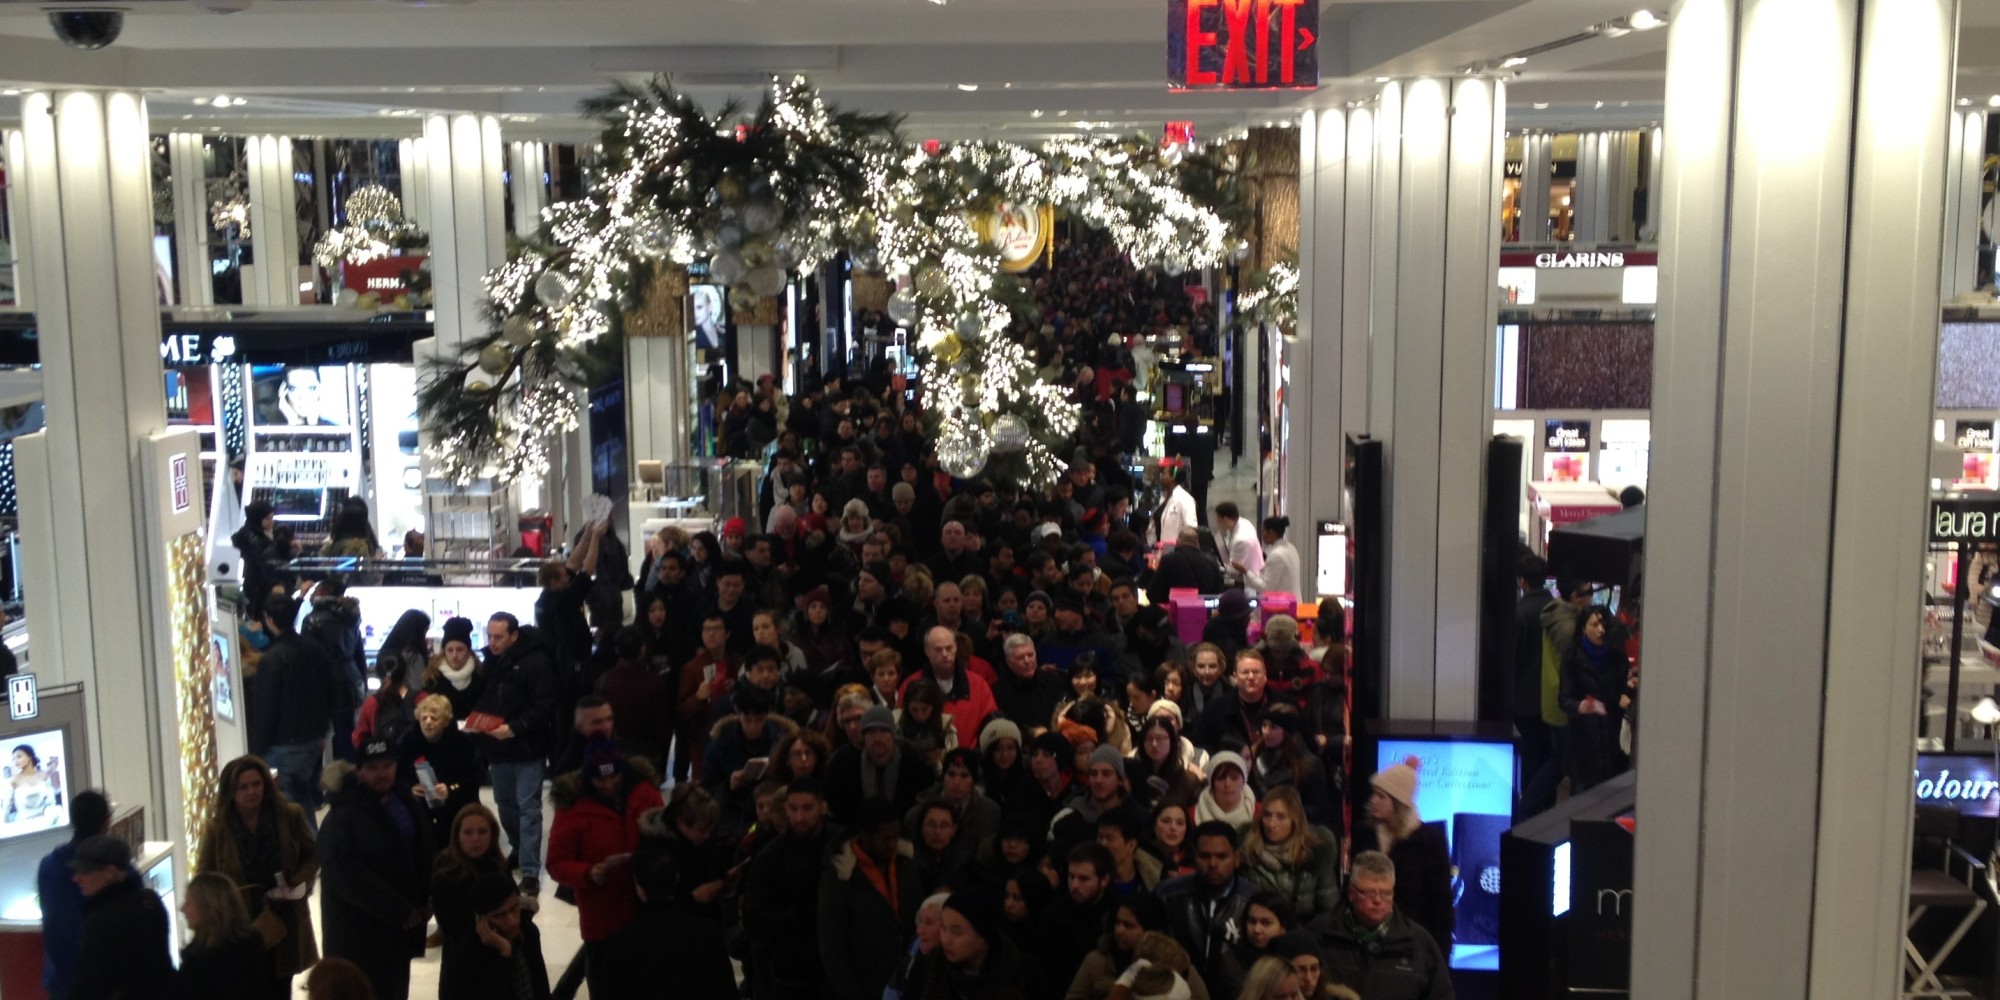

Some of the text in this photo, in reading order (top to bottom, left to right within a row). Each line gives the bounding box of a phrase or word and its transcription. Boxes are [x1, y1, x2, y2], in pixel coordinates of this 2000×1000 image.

[1186, 0, 1303, 84] EXIT
[1535, 252, 1624, 268] CLARINS
[367, 277, 405, 289] HERM
[1556, 427, 1579, 438] Great
[1967, 428, 1989, 438] Great
[1549, 436, 1563, 448] Gift
[1936, 505, 1986, 537] laura
